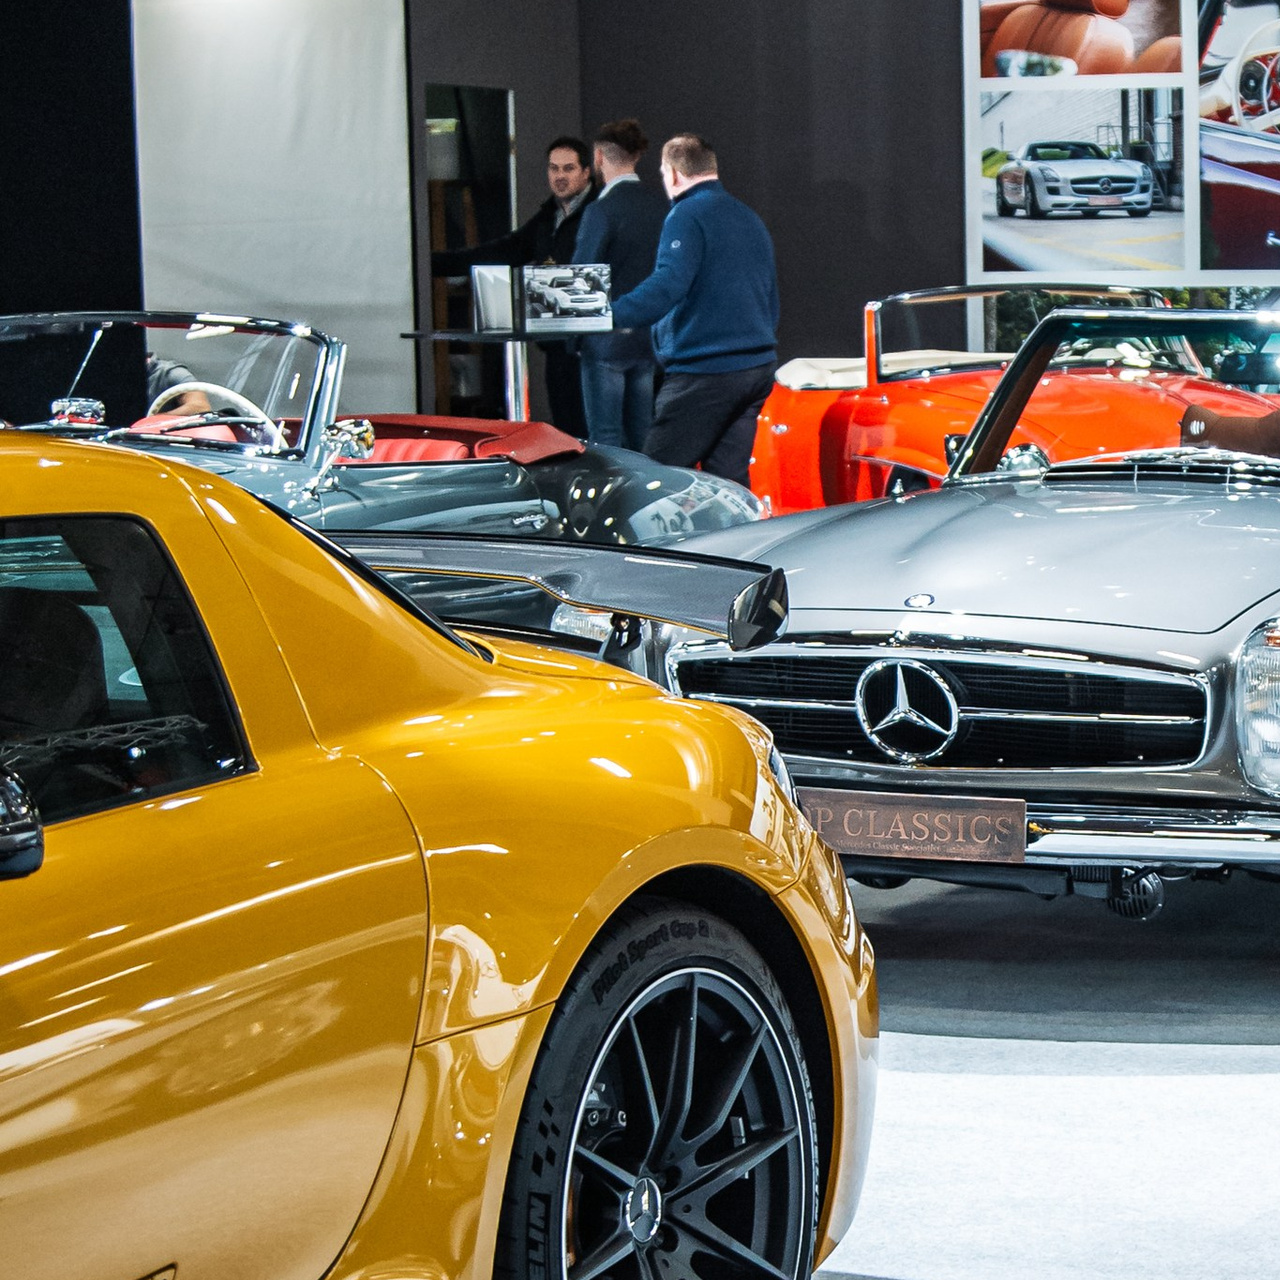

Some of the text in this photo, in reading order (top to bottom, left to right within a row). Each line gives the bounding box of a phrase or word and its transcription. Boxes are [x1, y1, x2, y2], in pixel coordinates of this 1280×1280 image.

[843, 808, 1013, 845] CLASSICS
[626, 923, 669, 964] Sport
[669, 919, 697, 940] Cup
[698, 919, 710, 939] 2
